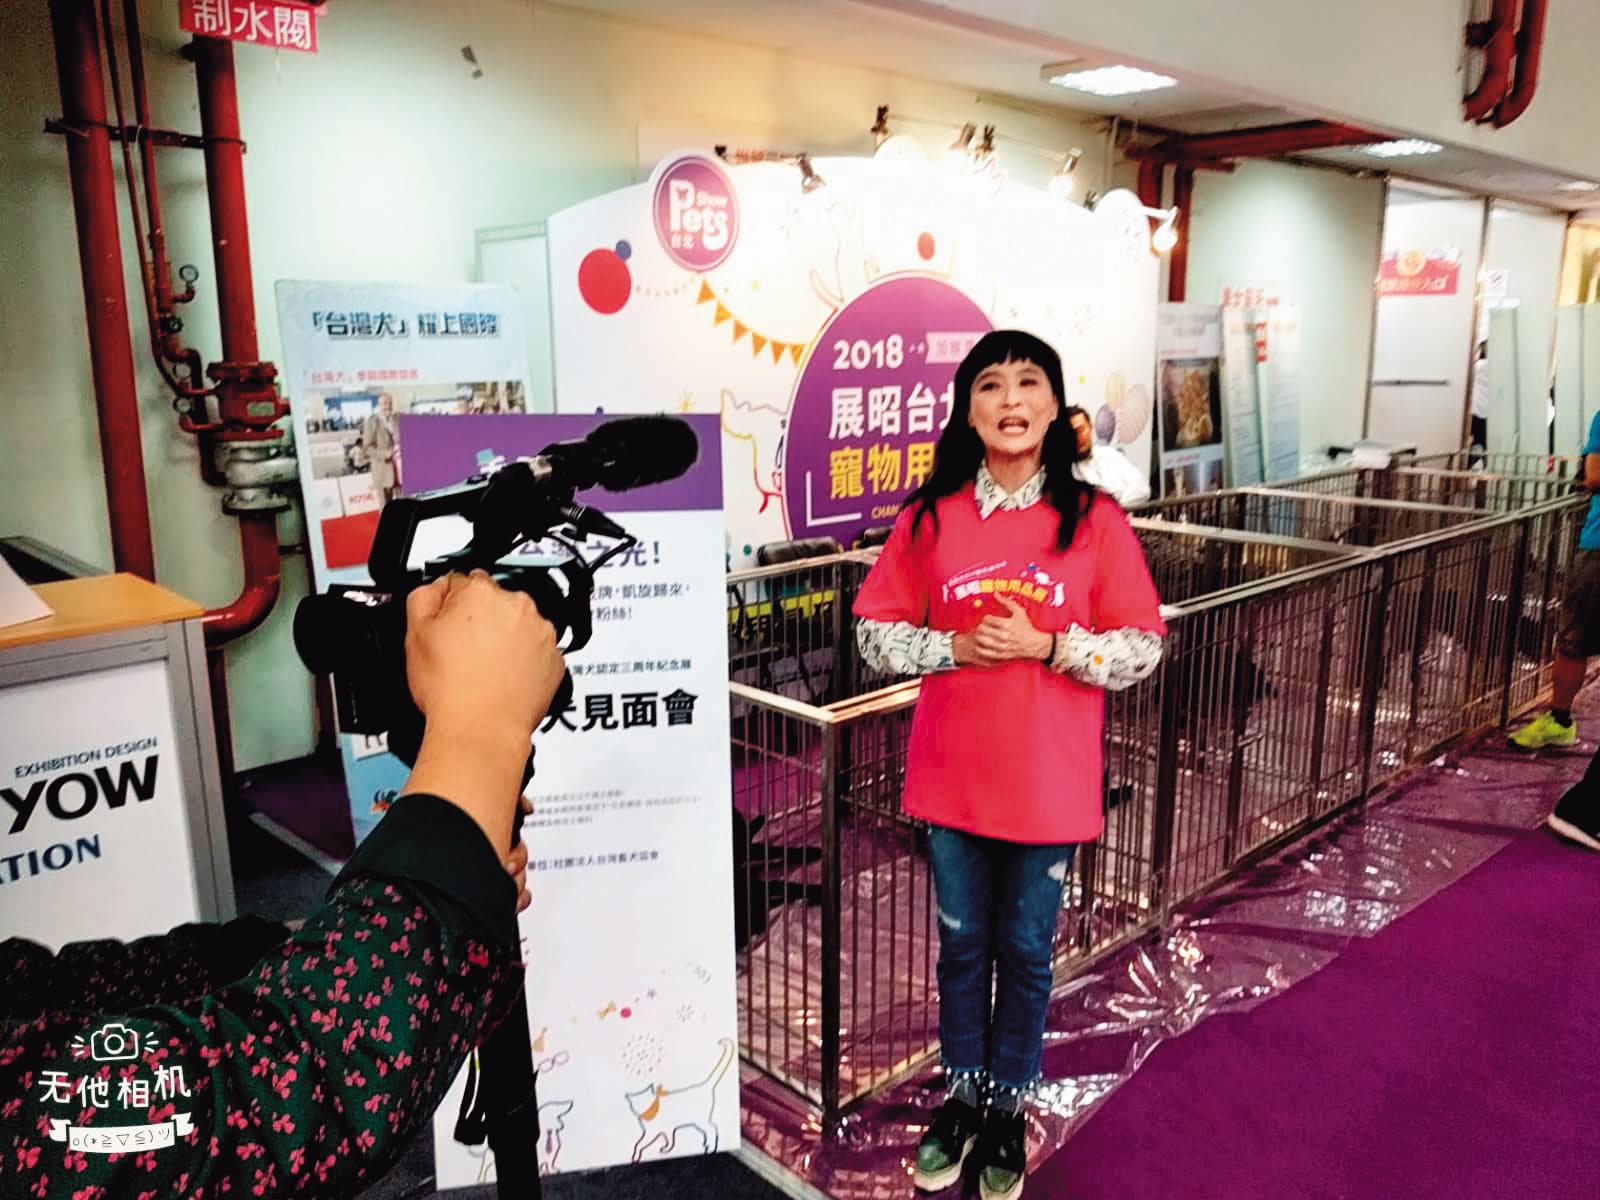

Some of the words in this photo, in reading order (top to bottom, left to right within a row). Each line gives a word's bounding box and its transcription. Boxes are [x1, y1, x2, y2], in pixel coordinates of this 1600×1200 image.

[669, 179, 729, 251] Pets
[833, 334, 904, 370] 2018
[15, 750, 101, 778] EXHIBITION
[105, 736, 158, 759] DESIGN
[0, 834, 101, 884] TION
